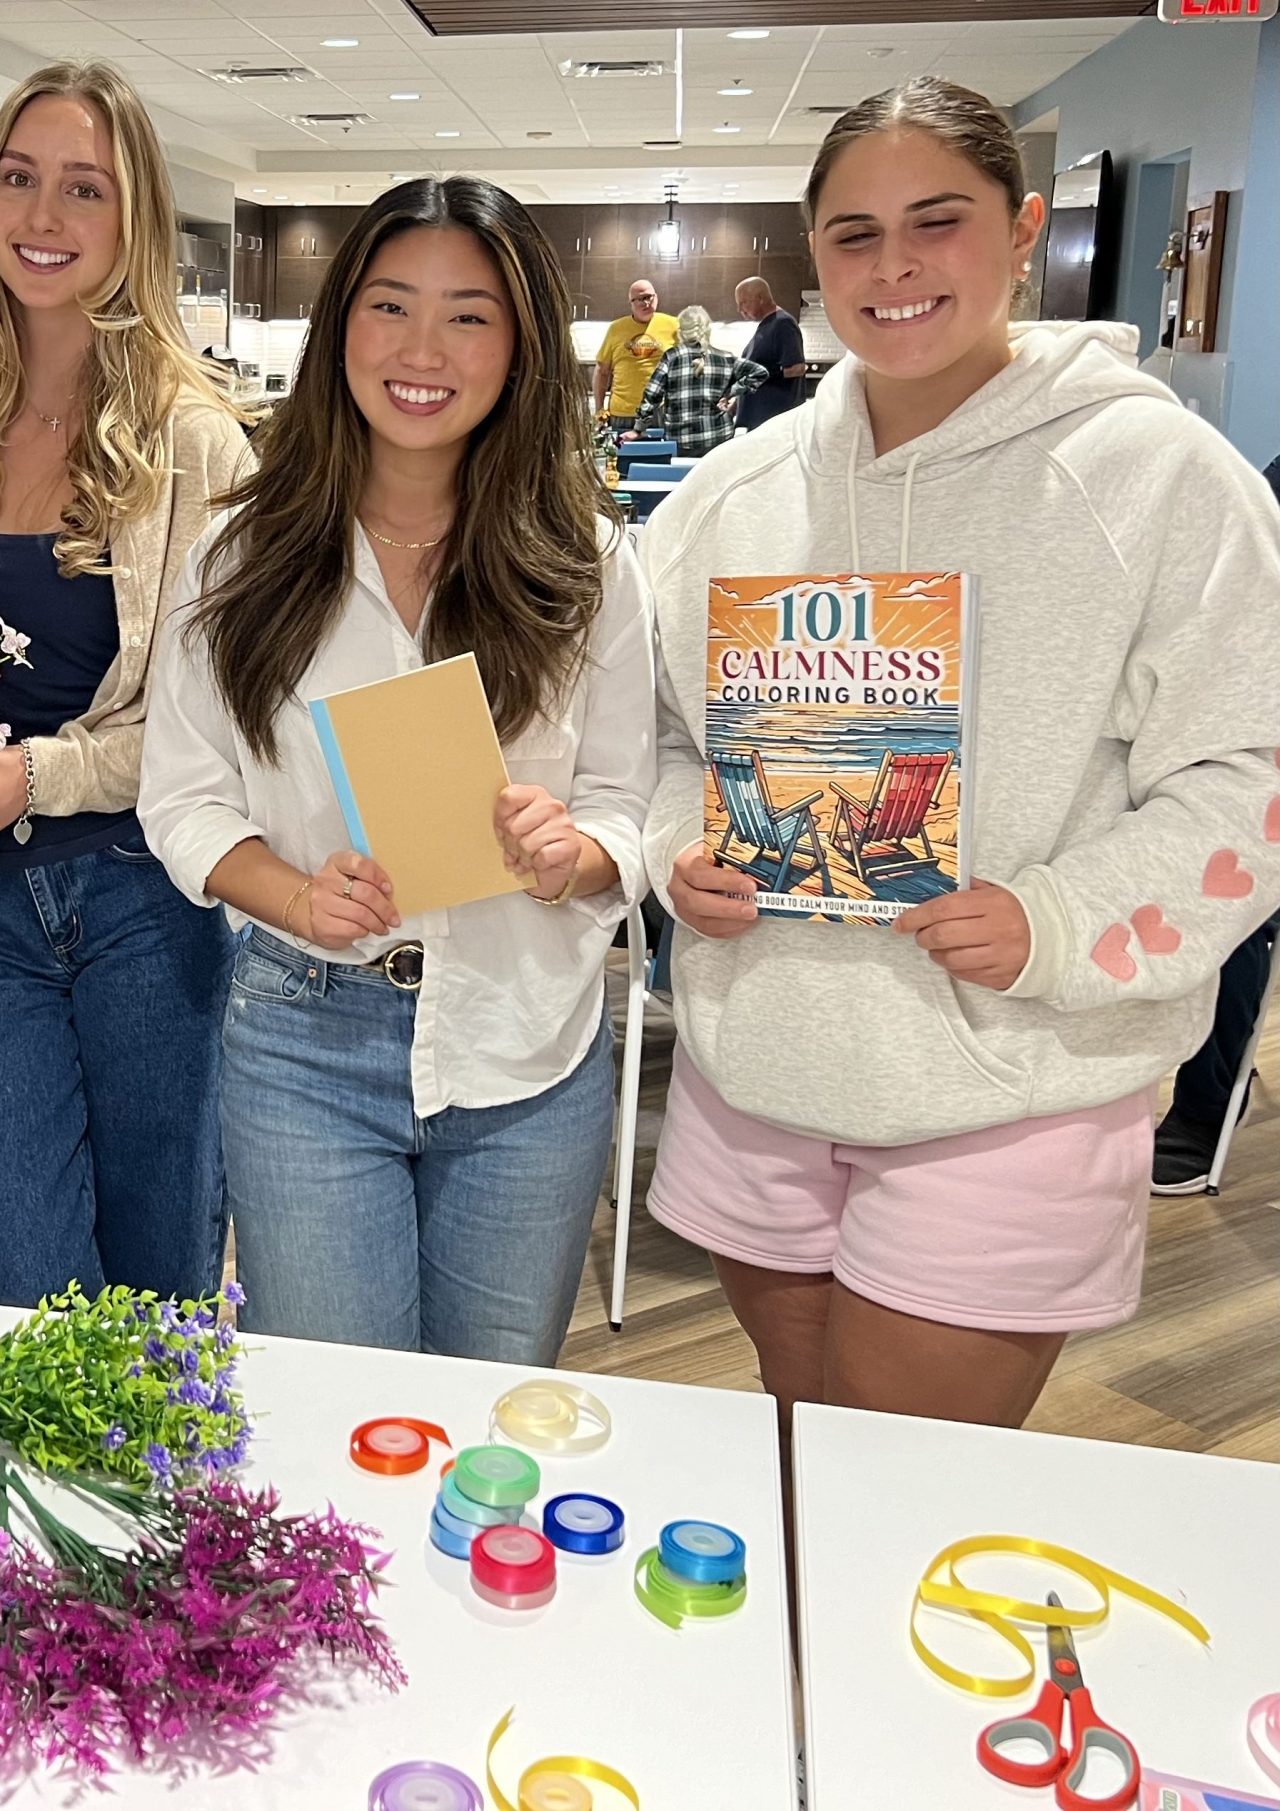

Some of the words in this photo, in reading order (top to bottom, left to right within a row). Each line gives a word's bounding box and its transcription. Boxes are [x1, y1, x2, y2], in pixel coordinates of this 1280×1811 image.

[779, 590, 870, 642] 101
[721, 650, 941, 682] CALMNESS
[722, 685, 851, 704] COLORING
[863, 687, 939, 706] BOOK
[765, 895, 786, 906] BOOK
[788, 897, 798, 907] TO
[799, 898, 822, 909] CALM
[824, 901, 846, 911] YOUR
[848, 903, 870, 913] MIND
[871, 904, 889, 914] AND
